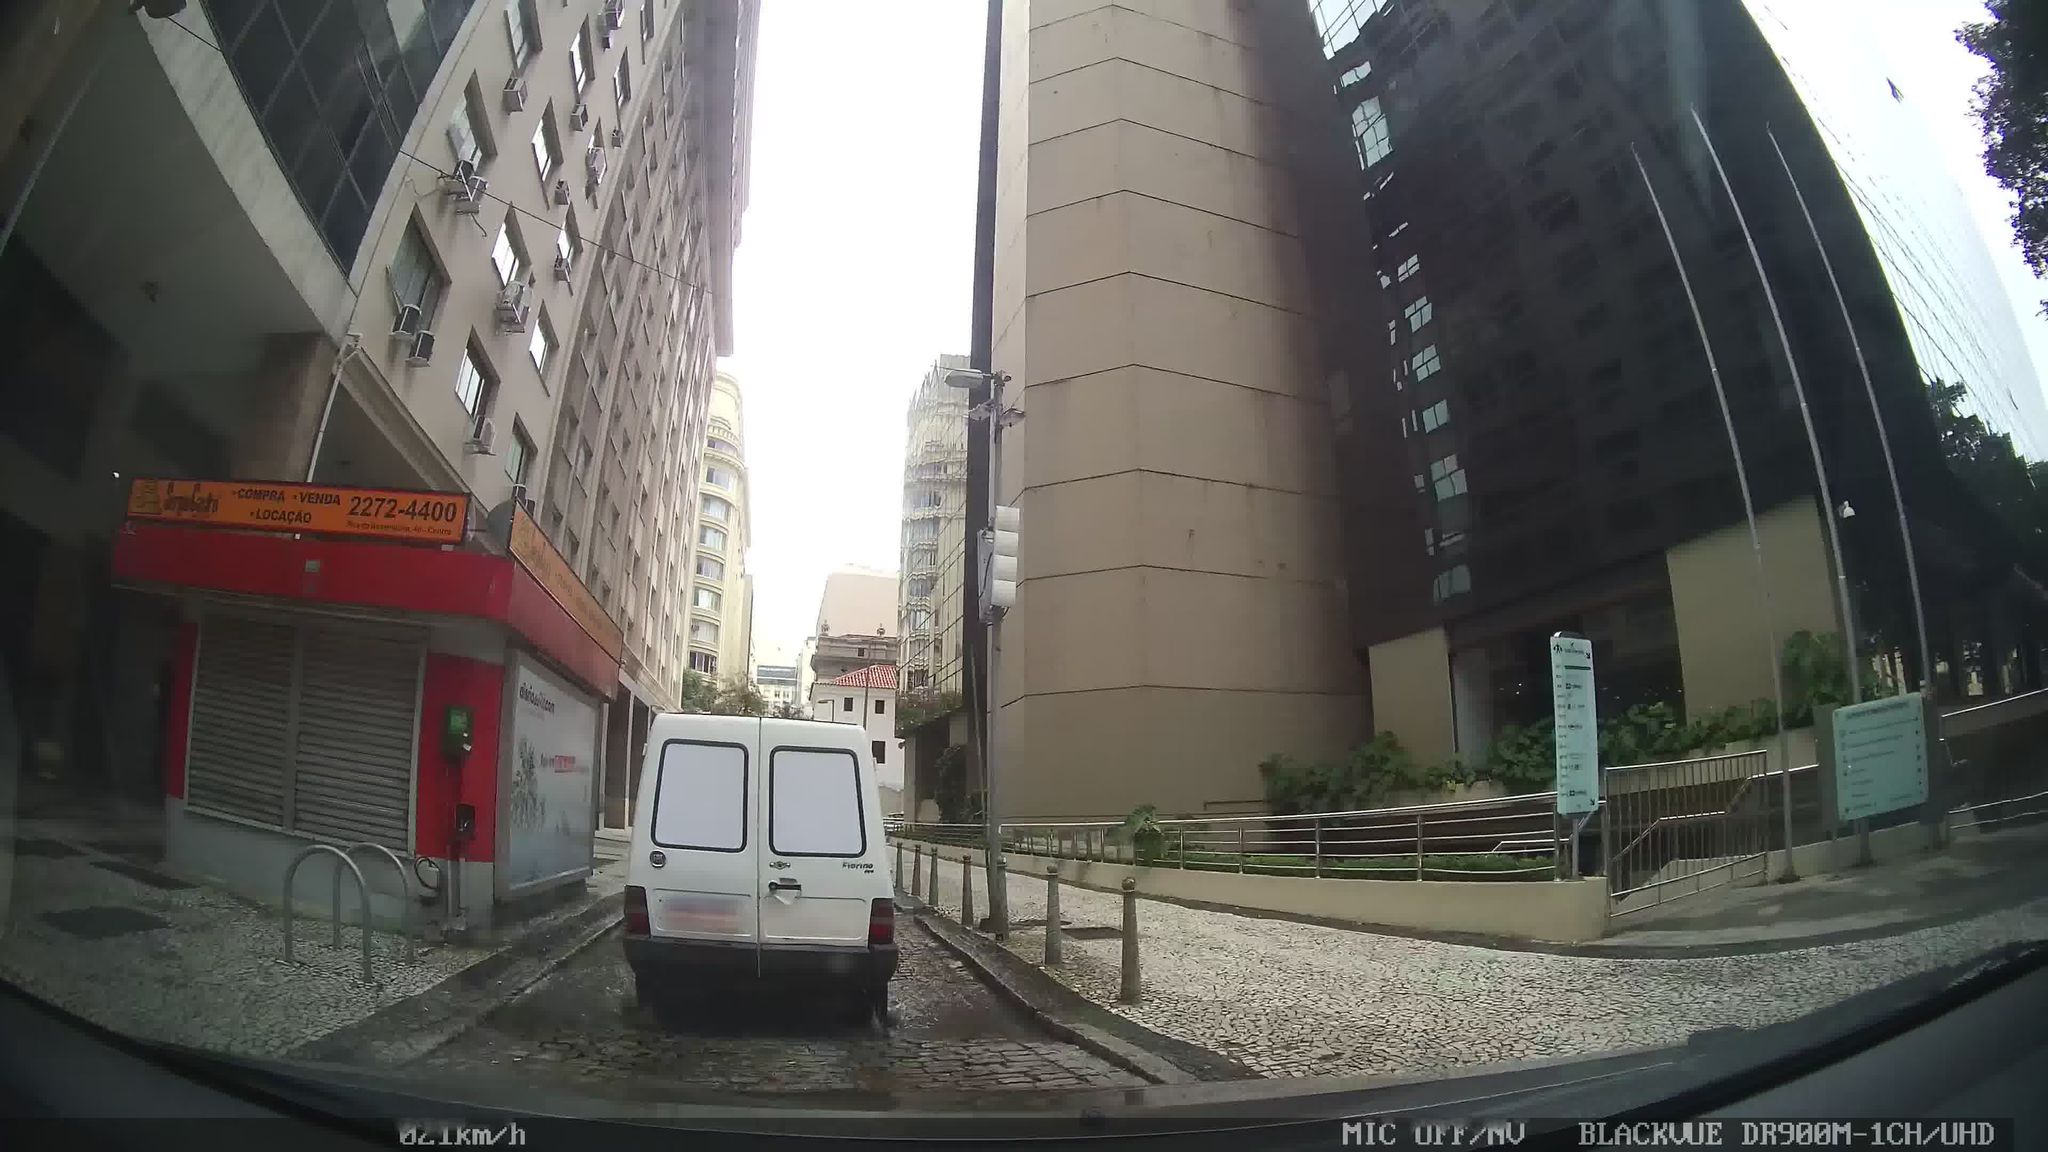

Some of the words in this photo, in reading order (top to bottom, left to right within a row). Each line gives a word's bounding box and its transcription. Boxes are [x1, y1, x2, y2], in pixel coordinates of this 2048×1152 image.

[238, 487, 285, 503] COMPRA
[299, 491, 341, 506] VENDA
[348, 495, 457, 523] 2272-4400
[842, 861, 874, 870] Fiorino
